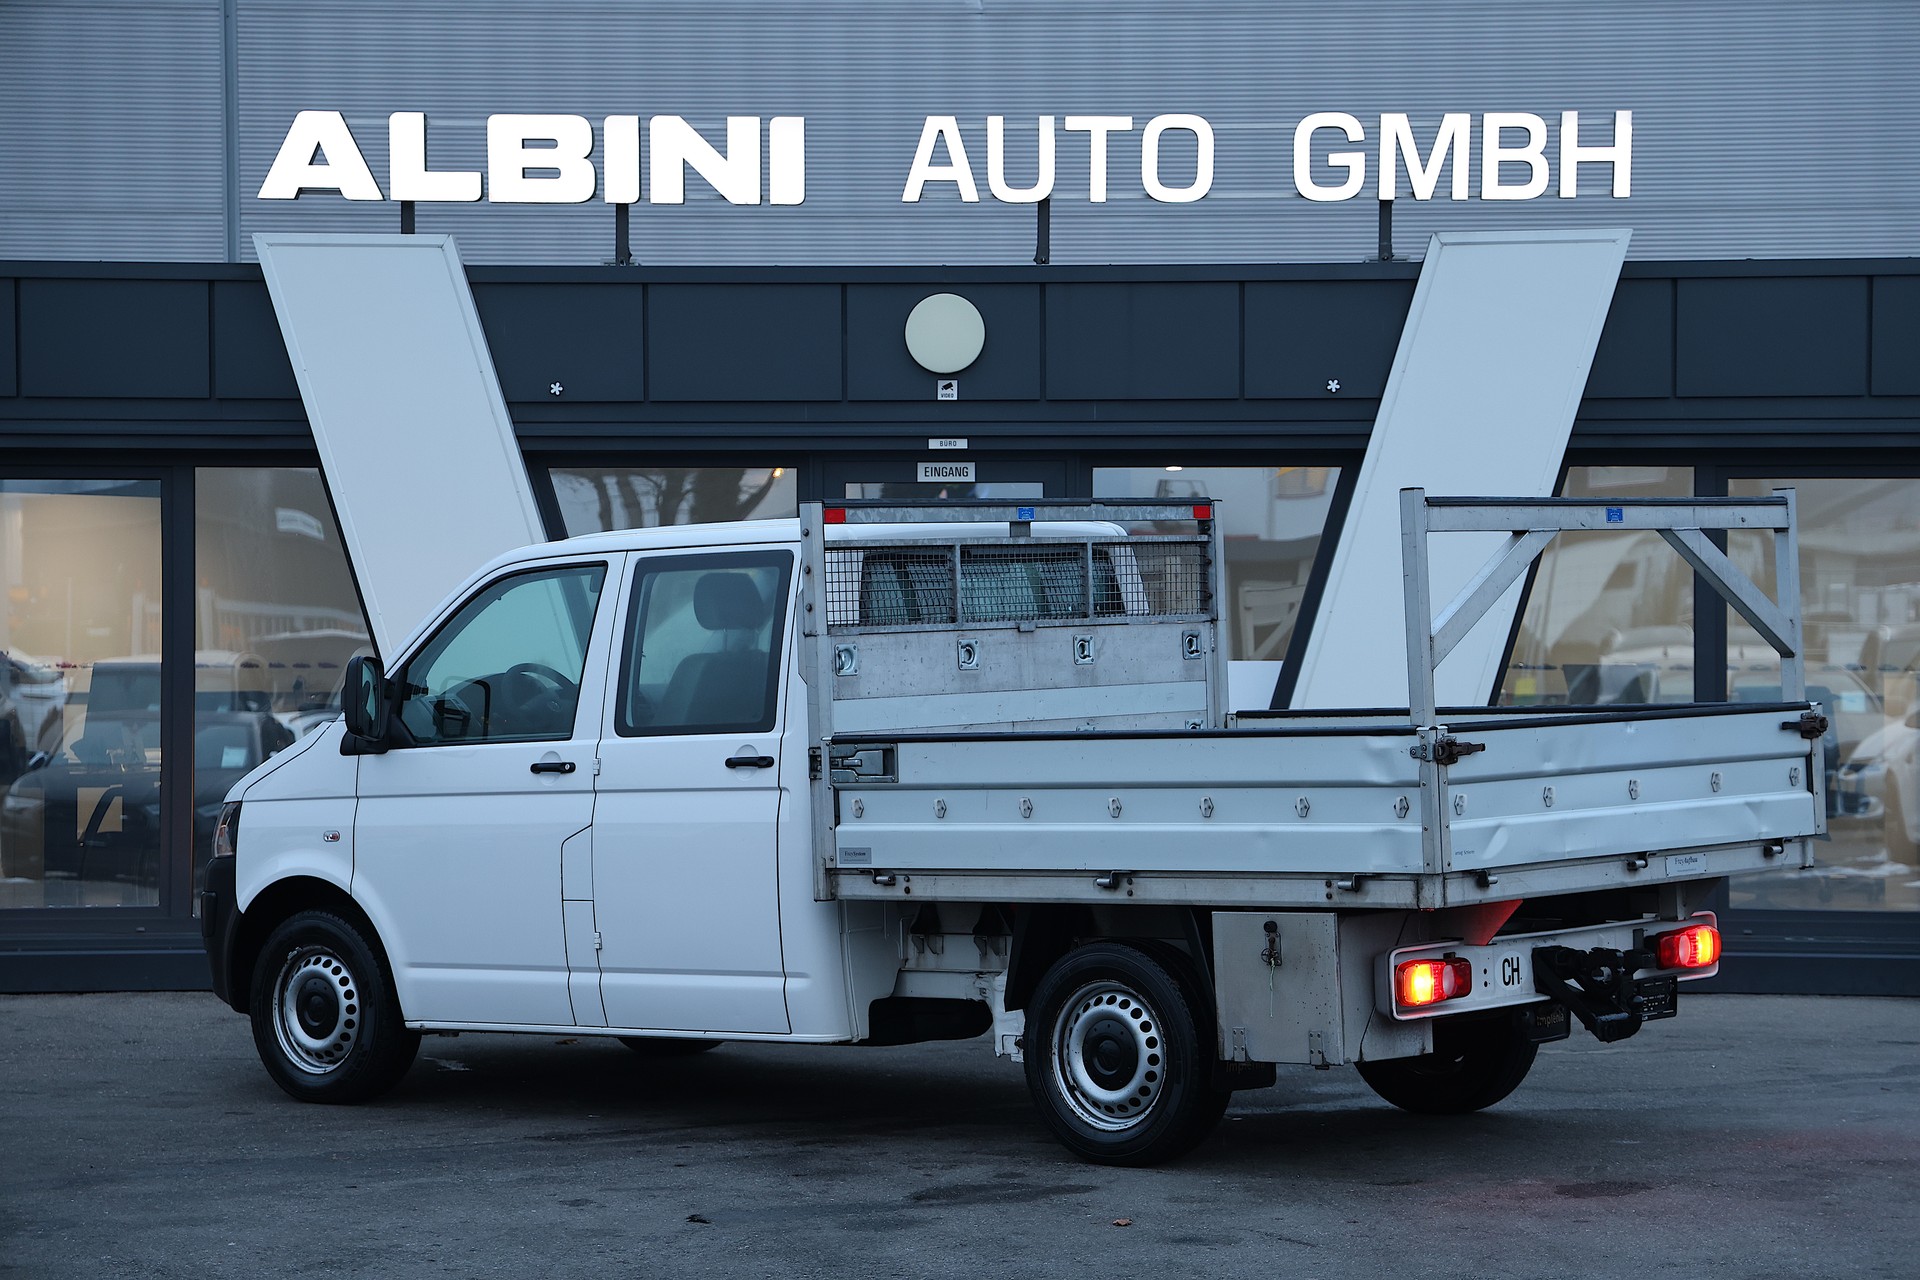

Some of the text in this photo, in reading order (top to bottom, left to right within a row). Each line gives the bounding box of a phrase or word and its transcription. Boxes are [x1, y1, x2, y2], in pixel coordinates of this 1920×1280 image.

[257, 109, 1633, 206] ALBINI AUTO GMBH
[924, 466, 969, 478] EINGANG
[1502, 956, 1520, 987] CH
